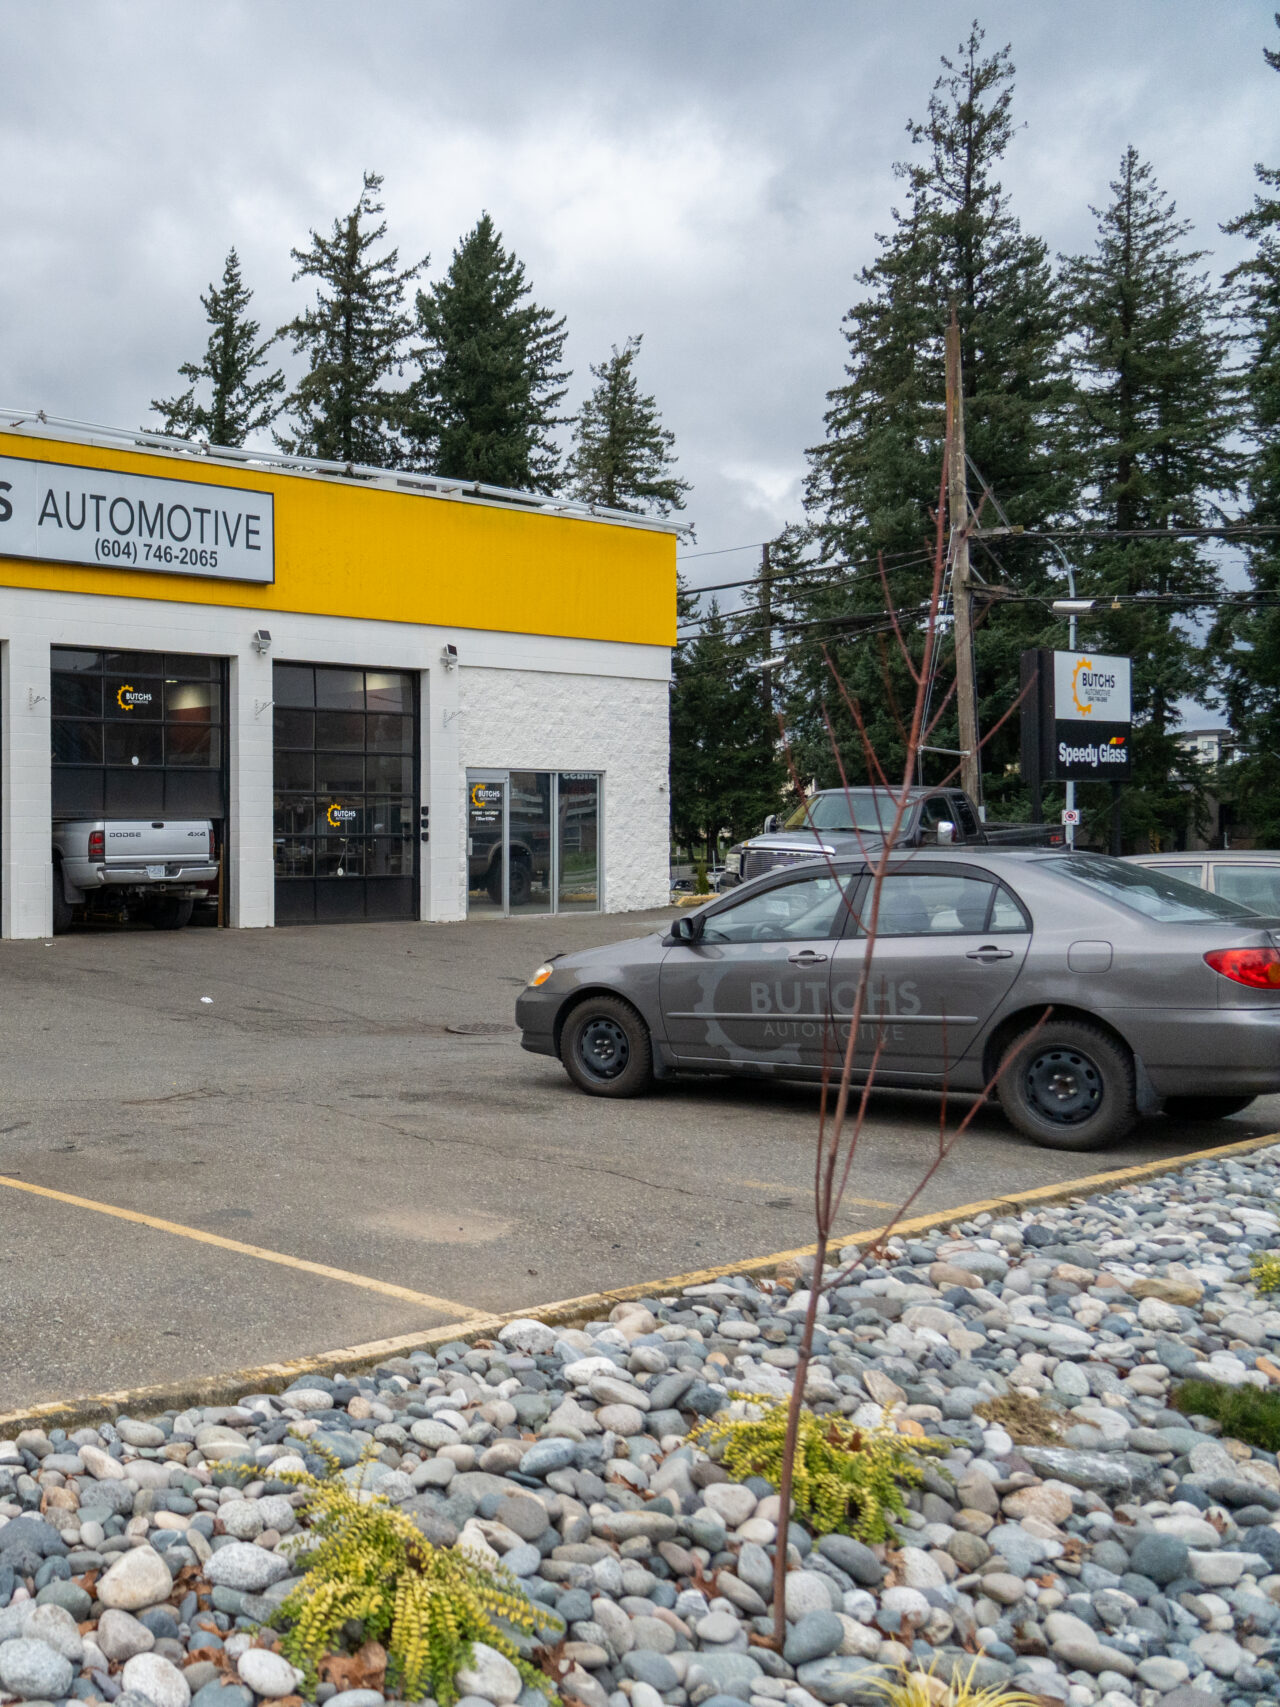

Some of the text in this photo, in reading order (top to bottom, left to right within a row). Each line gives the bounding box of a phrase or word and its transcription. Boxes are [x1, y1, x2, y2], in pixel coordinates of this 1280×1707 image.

[38, 488, 262, 552] AUTOMOTIVE
[94, 537, 219, 569] (604) 746-2065
[1082, 672, 1115, 688] BUTCHS
[125, 692, 153, 701] BUTCHS
[1059, 742, 1126, 767] Speedy Glass
